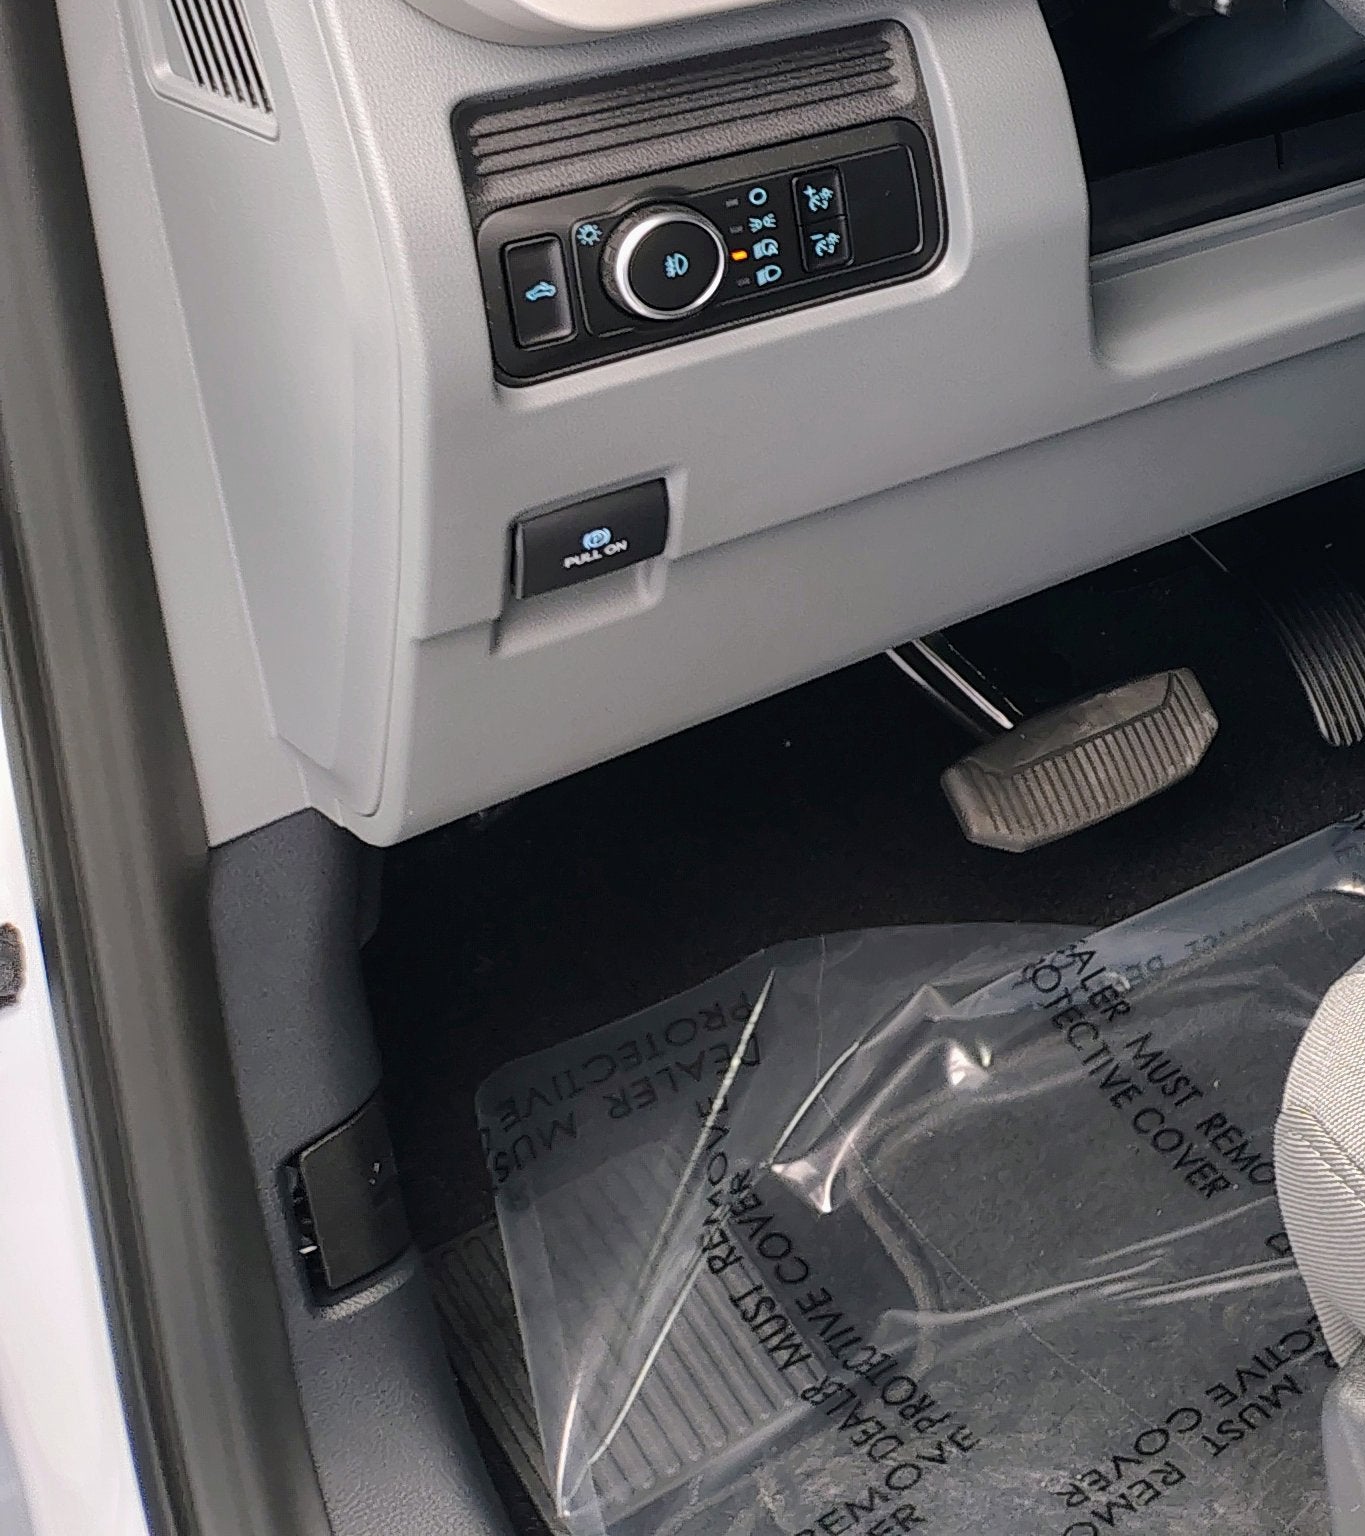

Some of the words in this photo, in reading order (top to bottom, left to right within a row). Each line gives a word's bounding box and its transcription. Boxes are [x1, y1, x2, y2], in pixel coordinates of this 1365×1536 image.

[563, 550, 603, 569] PULL
[603, 539, 629, 556] ON
[1124, 1032, 1203, 1107] MUST
[493, 1111, 578, 1183] MUS
[1132, 1107, 1232, 1200] COVER
[729, 1167, 810, 1285] COVER
[729, 1284, 814, 1373] MUST
[1051, 1407, 1202, 1508] COVER
[1202, 1374, 1303, 1457] MUST
[794, 1423, 982, 1536] EMOVE
